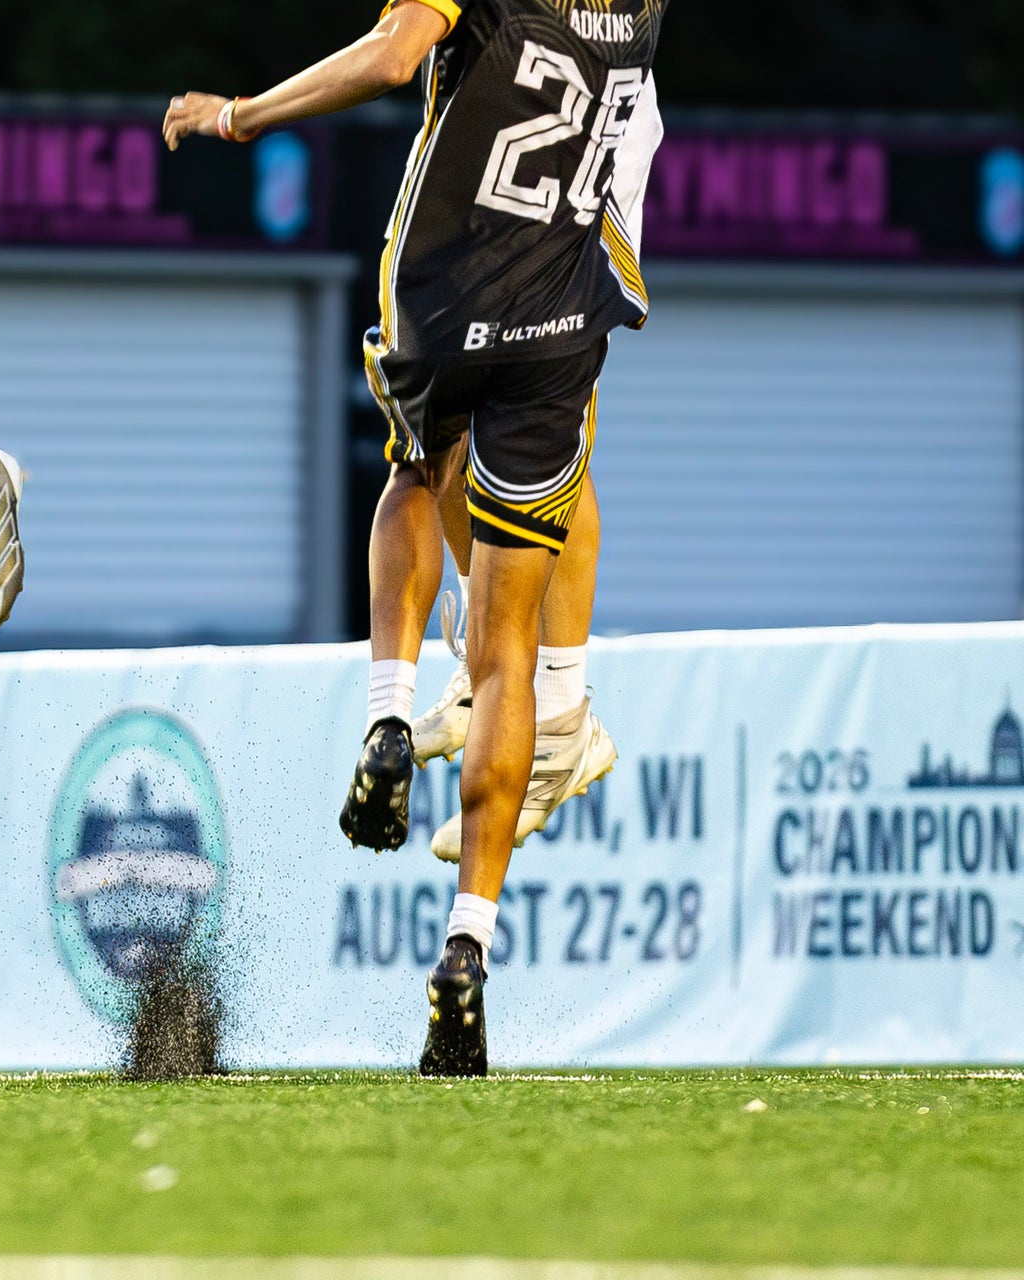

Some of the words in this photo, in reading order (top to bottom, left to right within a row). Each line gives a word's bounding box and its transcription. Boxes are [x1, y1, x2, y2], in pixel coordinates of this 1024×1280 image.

[570, 8, 634, 42] ADKINS
[502, 313, 585, 342] ULTIMATE
[638, 754, 705, 841] WI
[776, 749, 870, 795] 2026
[773, 803, 1020, 876] CHAMPION
[335, 883, 548, 968] AUGST
[564, 880, 701, 963] 27-28
[773, 886, 996, 958] WEEKEND
